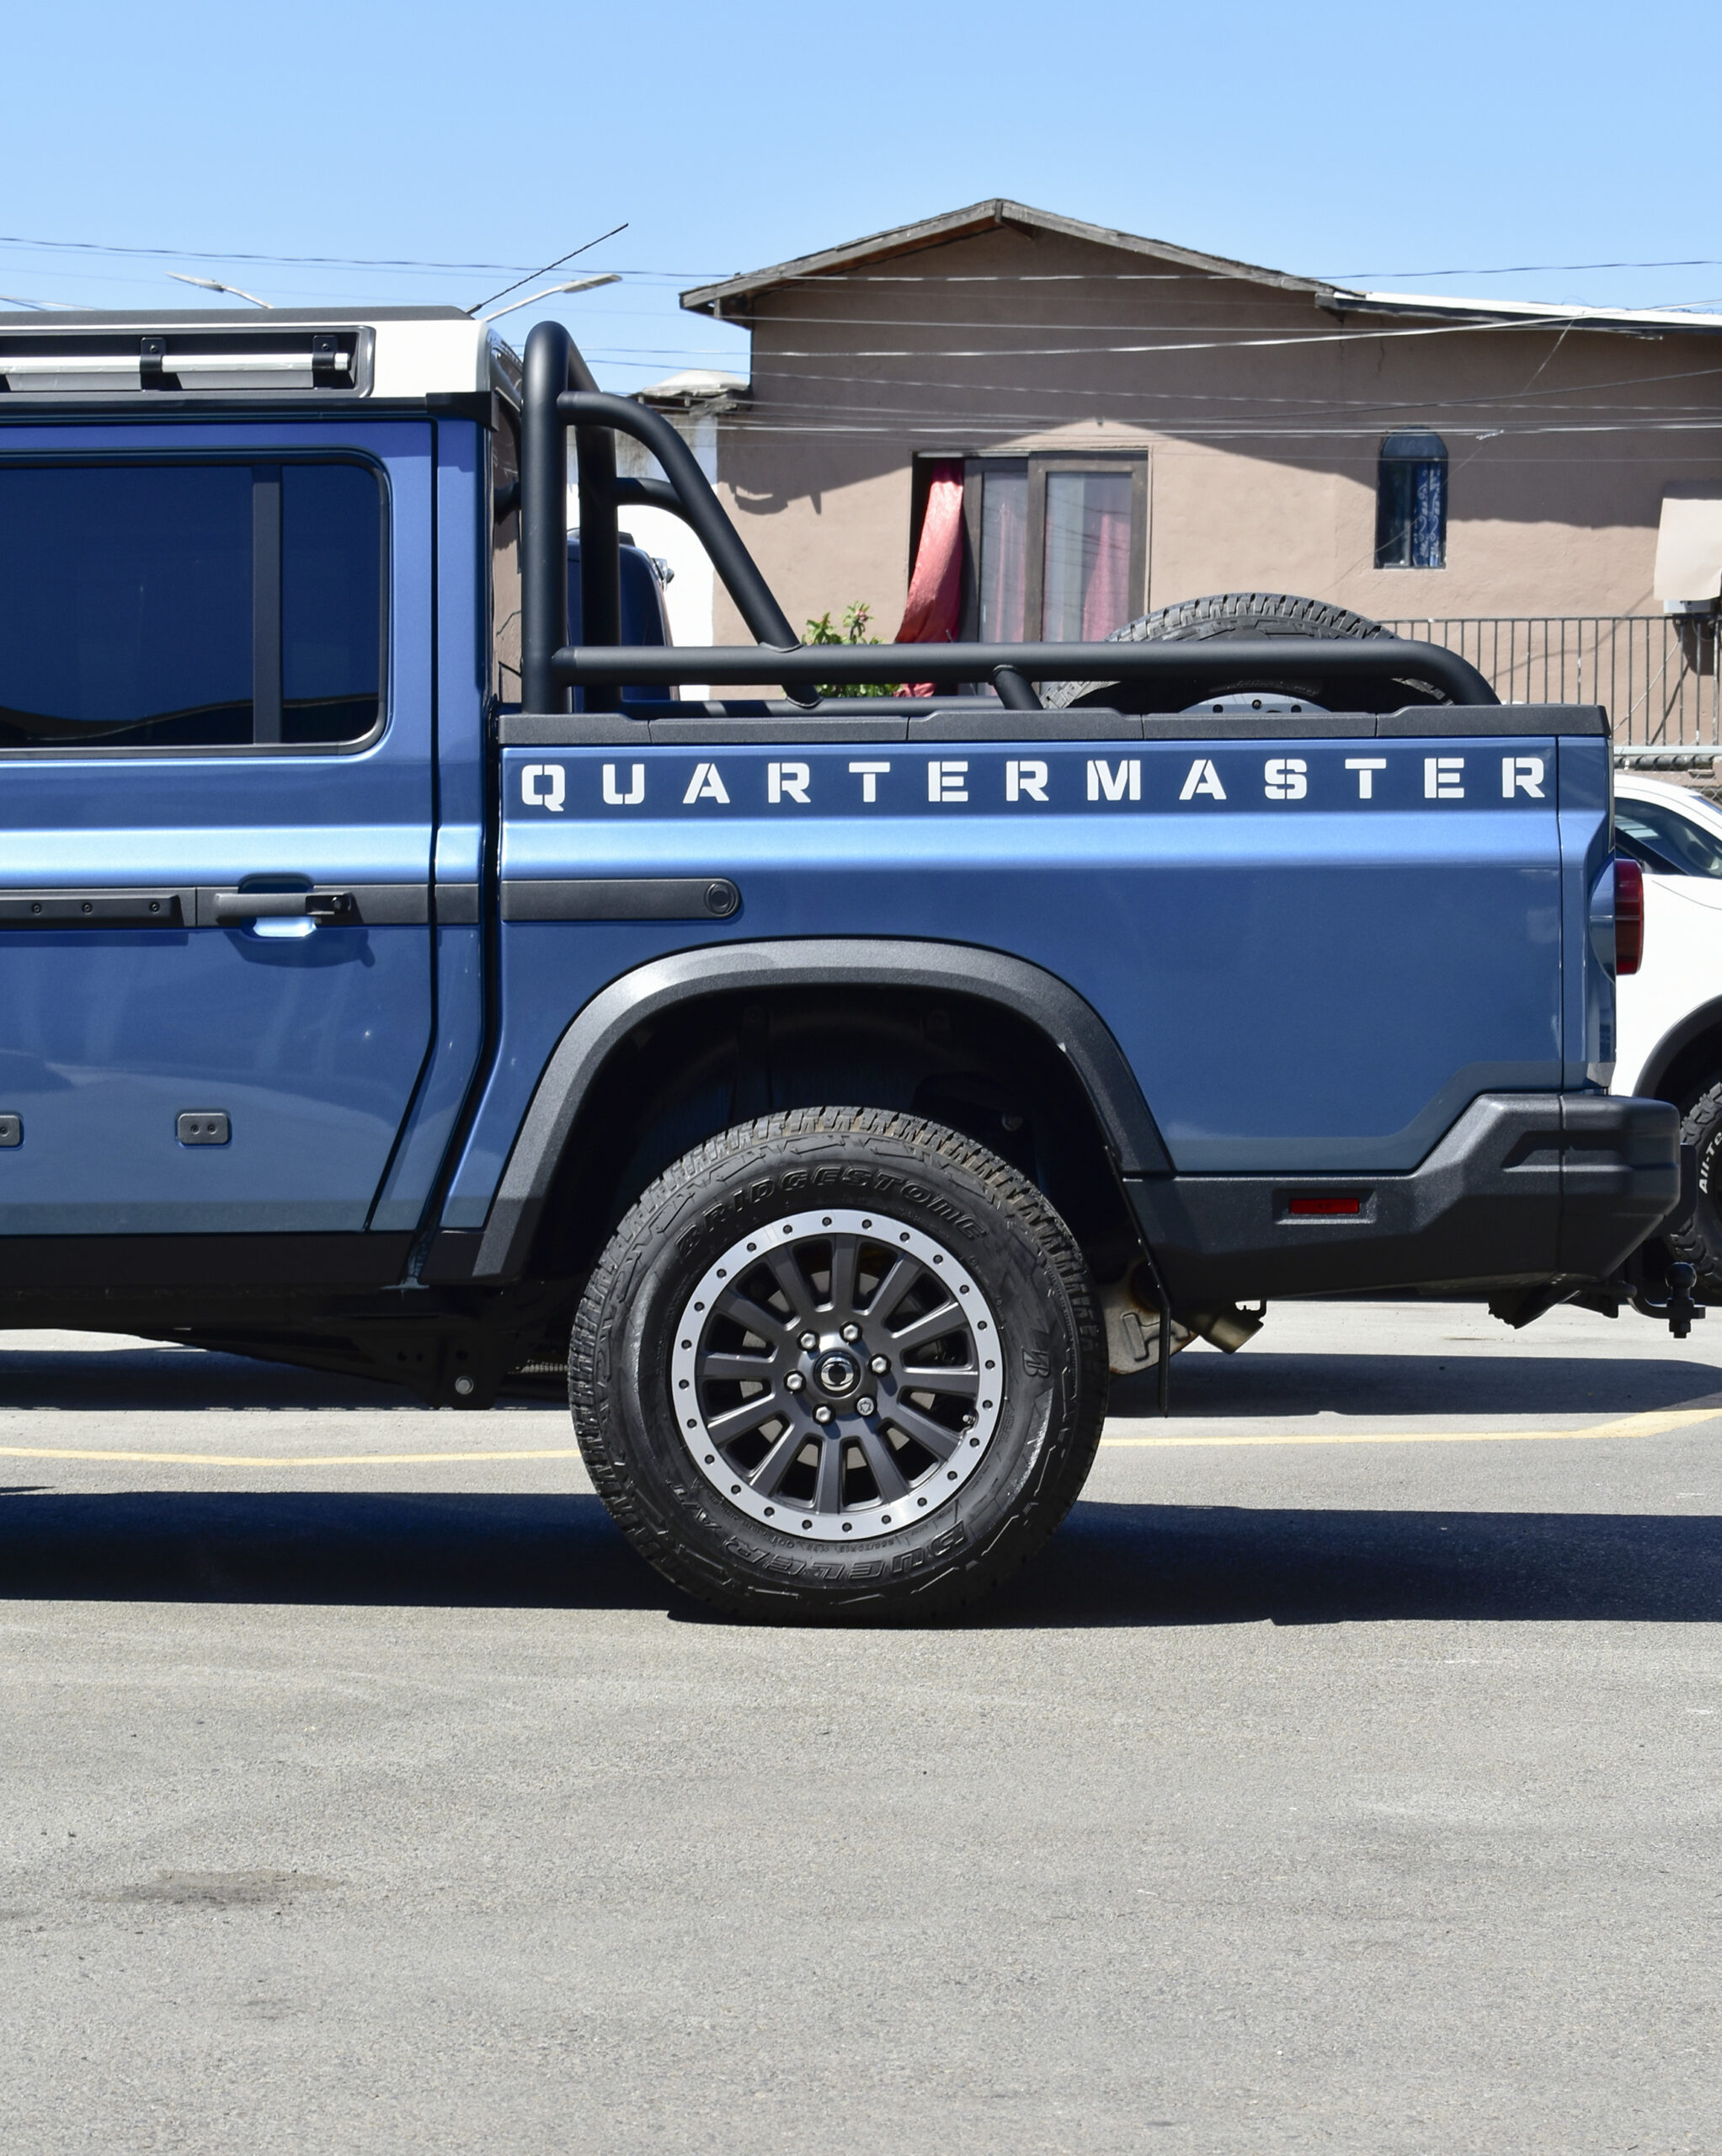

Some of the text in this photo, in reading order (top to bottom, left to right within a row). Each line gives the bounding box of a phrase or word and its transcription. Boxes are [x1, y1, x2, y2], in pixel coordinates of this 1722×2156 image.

[520, 757, 1546, 812] QUARTERMASTER
[674, 1165, 988, 1259] BRIDGESTONE
[722, 1520, 967, 1581] DUELER
